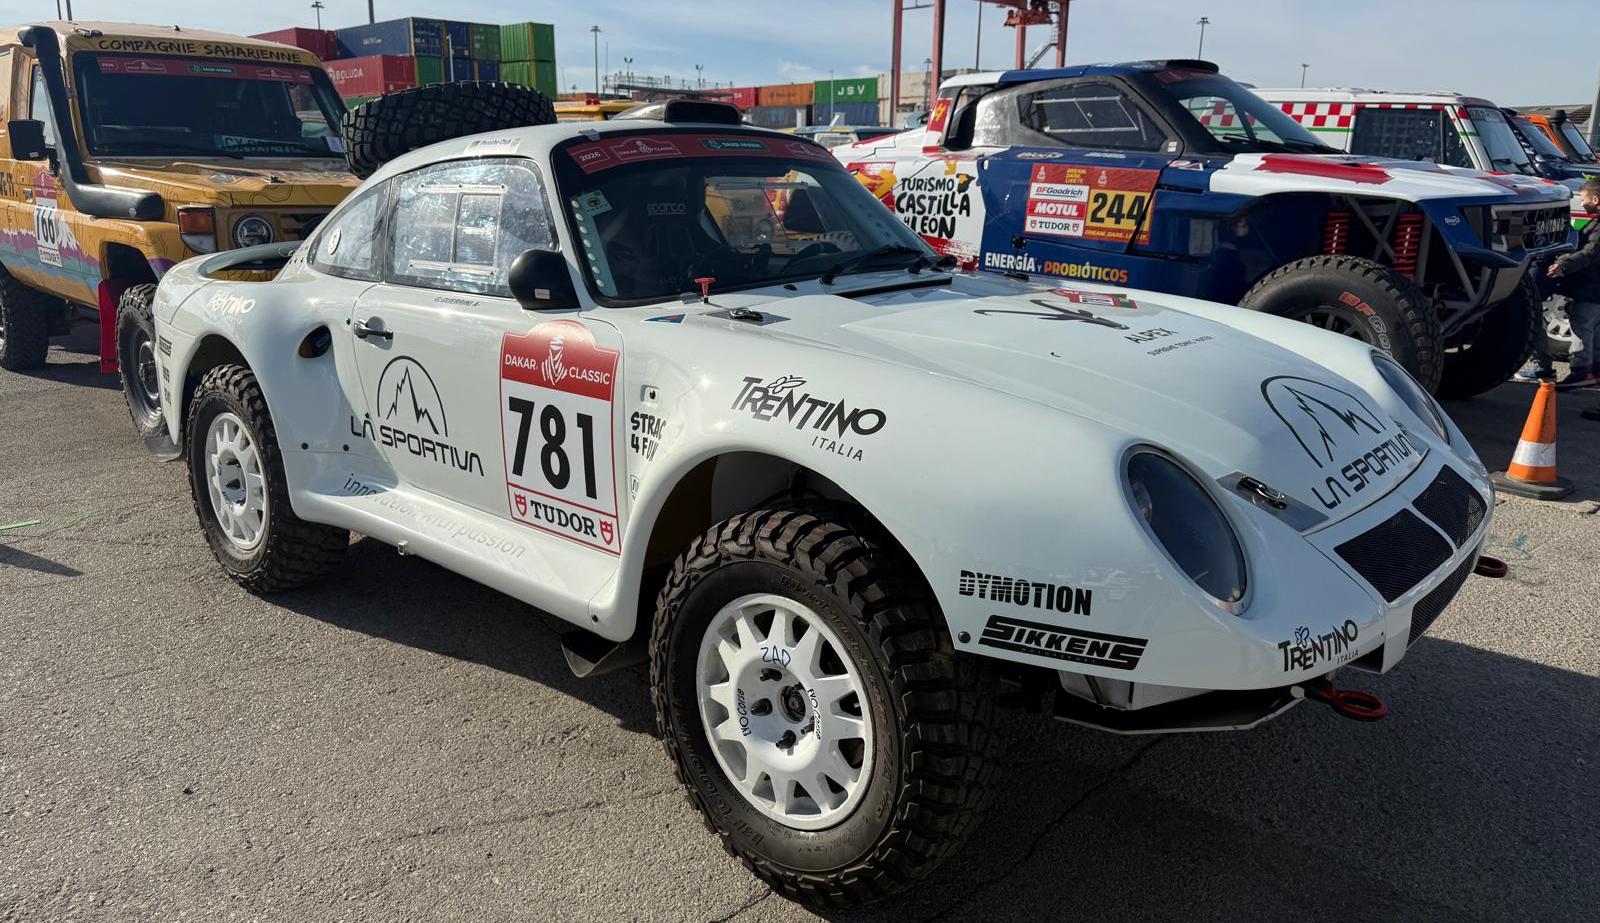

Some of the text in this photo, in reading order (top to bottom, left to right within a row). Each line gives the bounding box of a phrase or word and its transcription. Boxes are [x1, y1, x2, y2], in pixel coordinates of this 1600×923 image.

[98, 39, 302, 63] COMPAGNIE SAHARIENNE
[579, 151, 601, 162] 2026
[1036, 186, 1083, 197] BFGoodrich
[36, 204, 56, 245] 766
[1034, 202, 1079, 217] MOTUL
[1090, 192, 1147, 226] 244
[910, 213, 956, 240] LEÓN
[1038, 221, 1071, 231] TUDOR
[984, 252, 1036, 272] ENERGÍA
[1043, 261, 1128, 283] PROBIÓTICOS
[505, 353, 611, 386] DAKAR CLASSIC
[730, 376, 887, 440] TRENTINO
[379, 424, 485, 477] SPORTIVA
[508, 396, 598, 500] 781
[811, 435, 864, 462] ITALIA
[1311, 432, 1418, 510] LA SPORTIVA
[530, 499, 597, 538] TUDOR
[958, 569, 1093, 616] DYMOTION
[981, 619, 1147, 666] SIKKENS
[1277, 619, 1359, 673] TRENTINO
[1336, 648, 1359, 665] ITALIA
